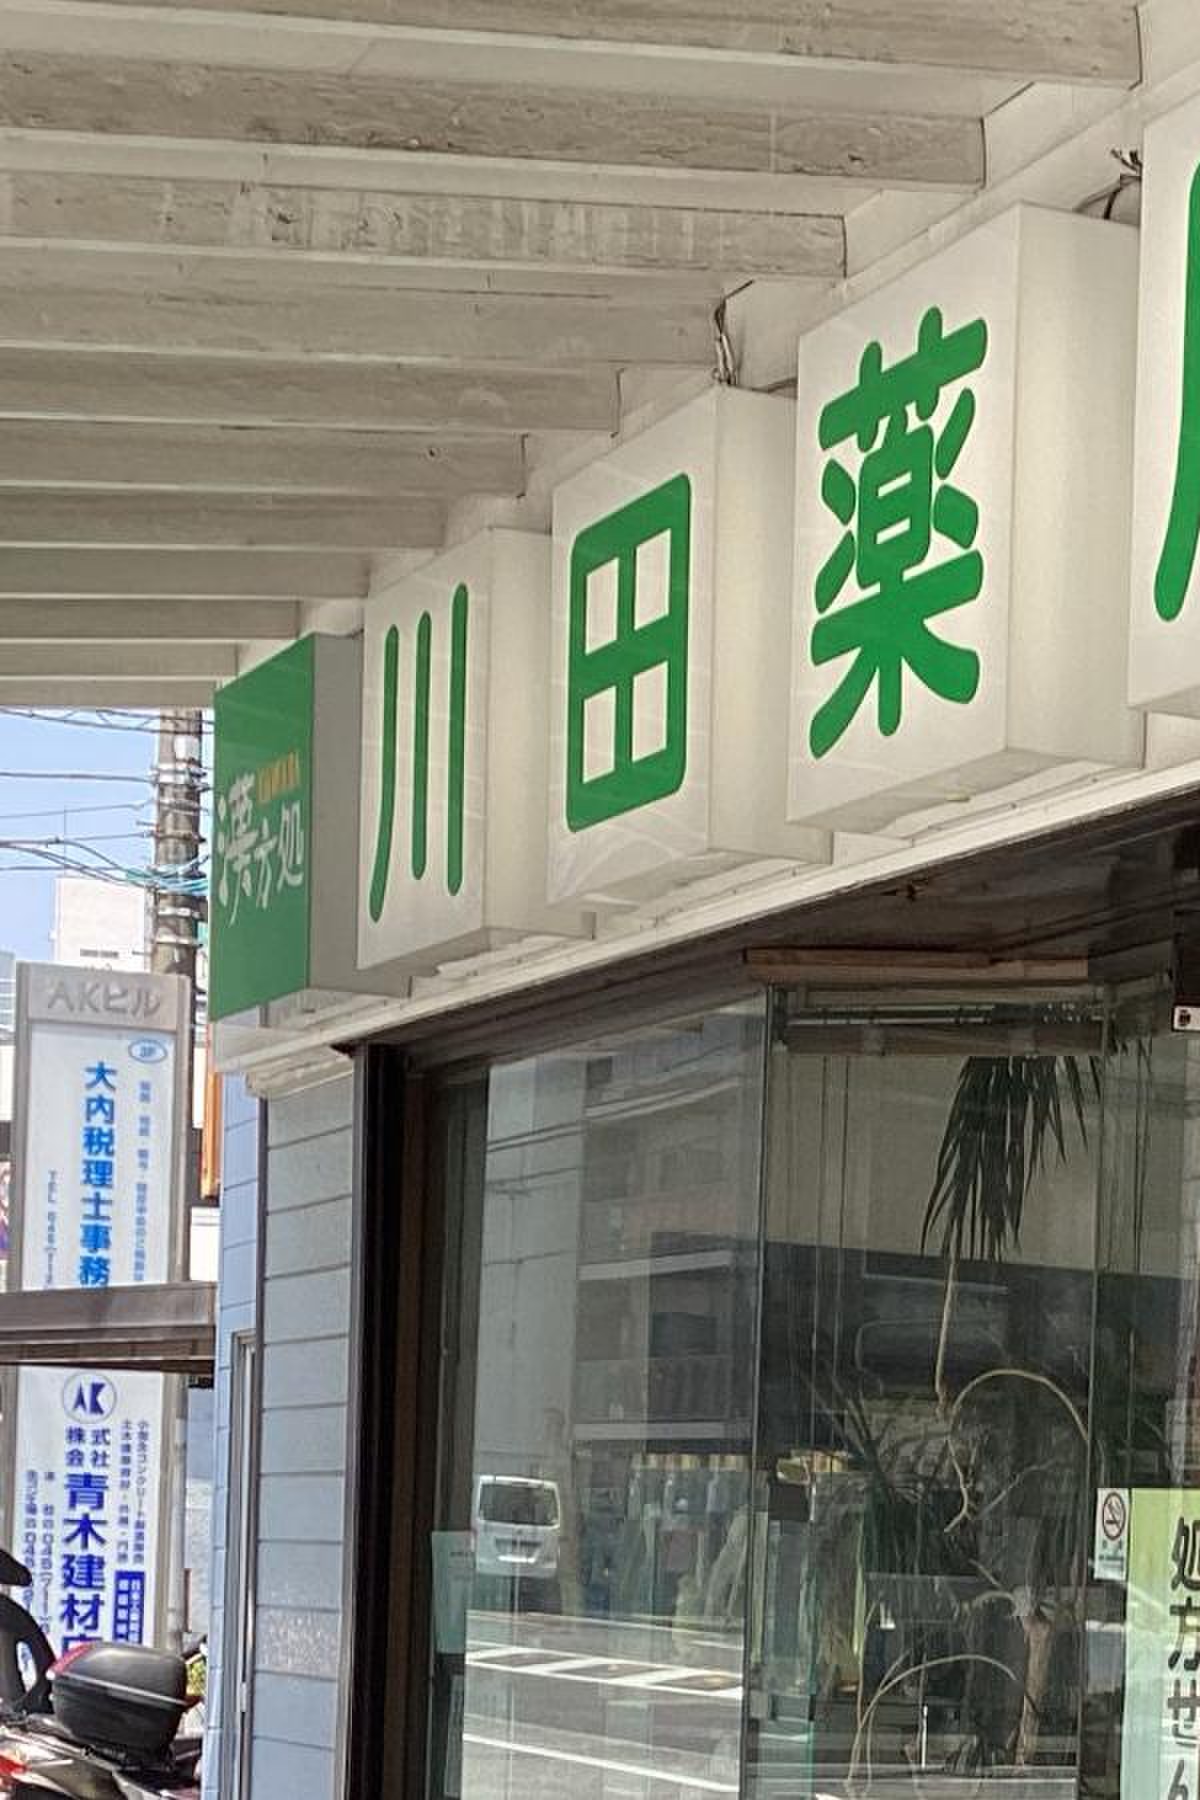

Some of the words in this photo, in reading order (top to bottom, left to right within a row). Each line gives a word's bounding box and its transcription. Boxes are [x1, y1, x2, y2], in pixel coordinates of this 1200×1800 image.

[217, 772, 304, 927] 漢方処
[48, 980, 161, 1017] AKビル
[78, 1061, 117, 1287] 大内税理士事務
